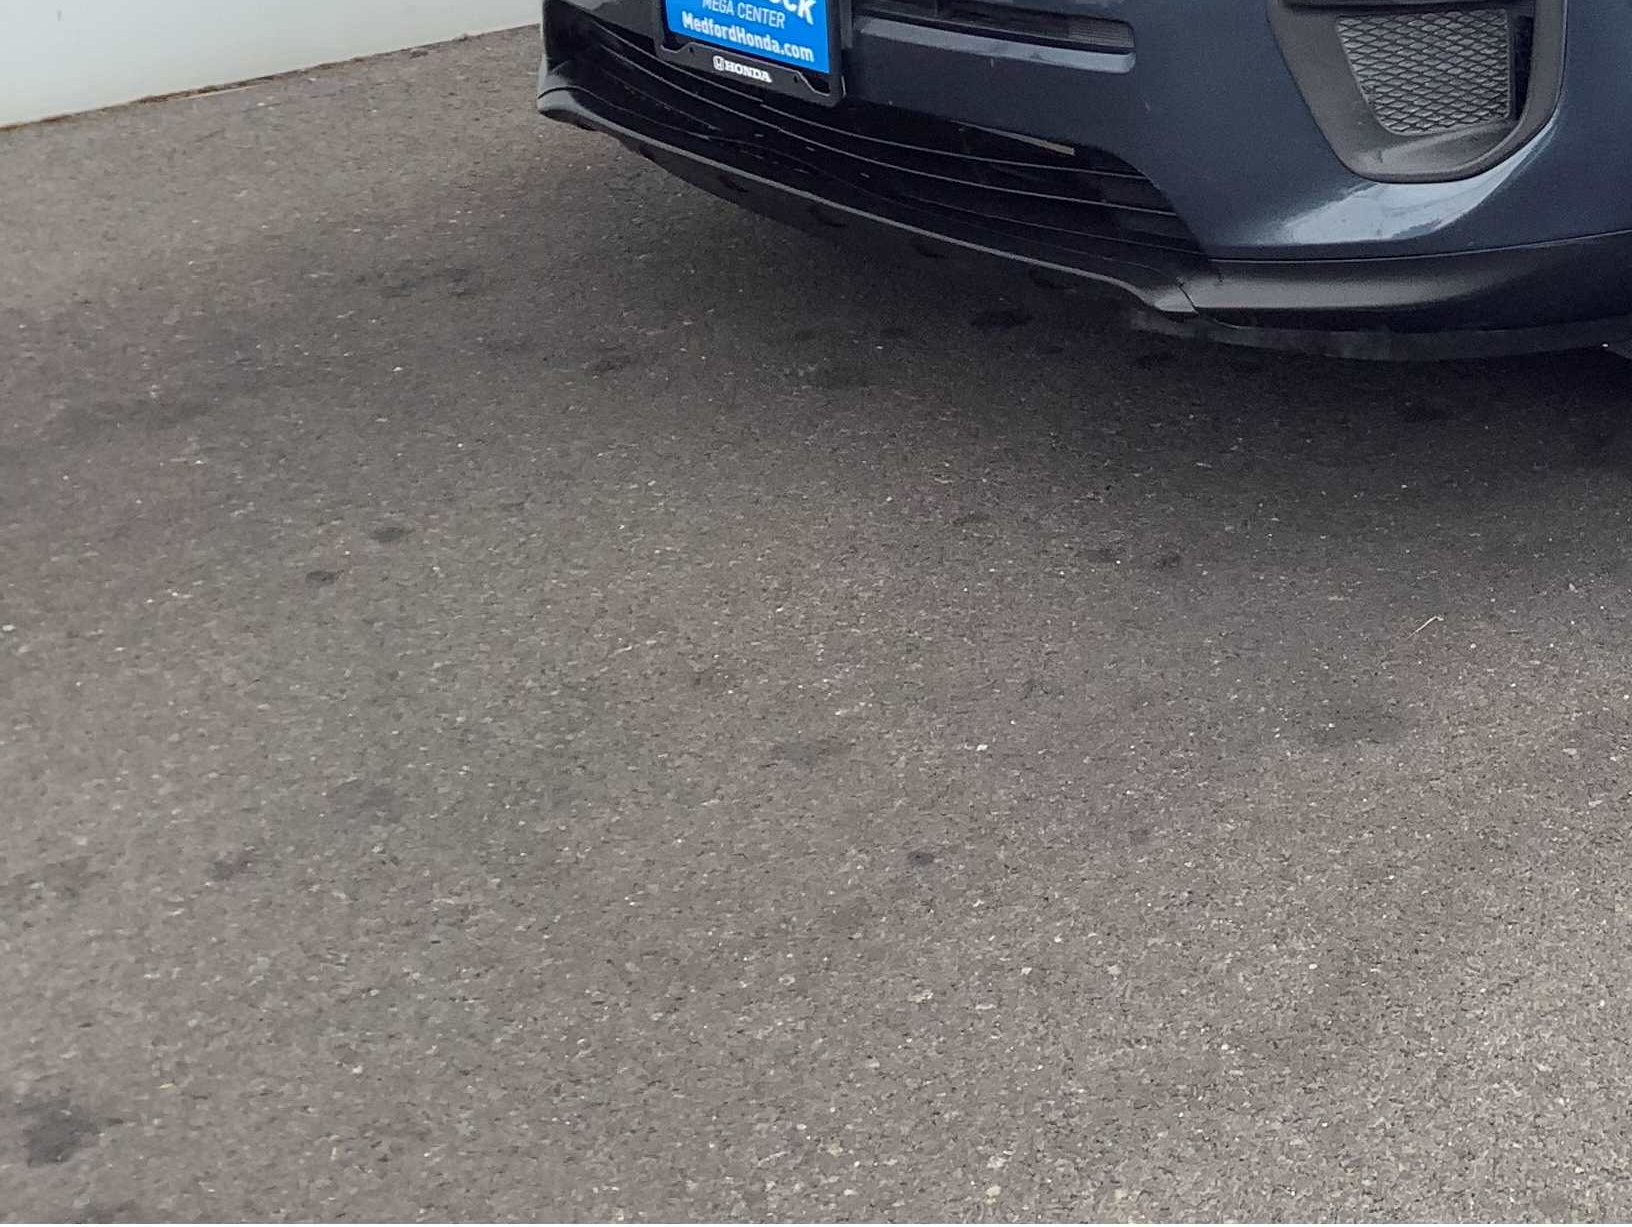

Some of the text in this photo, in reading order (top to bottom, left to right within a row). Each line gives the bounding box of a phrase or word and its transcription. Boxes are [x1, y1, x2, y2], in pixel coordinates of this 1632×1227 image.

[737, 2, 786, 29] CENTER
[682, 11, 815, 63] MedfordHonda.com
[723, 60, 772, 83] HONDA
